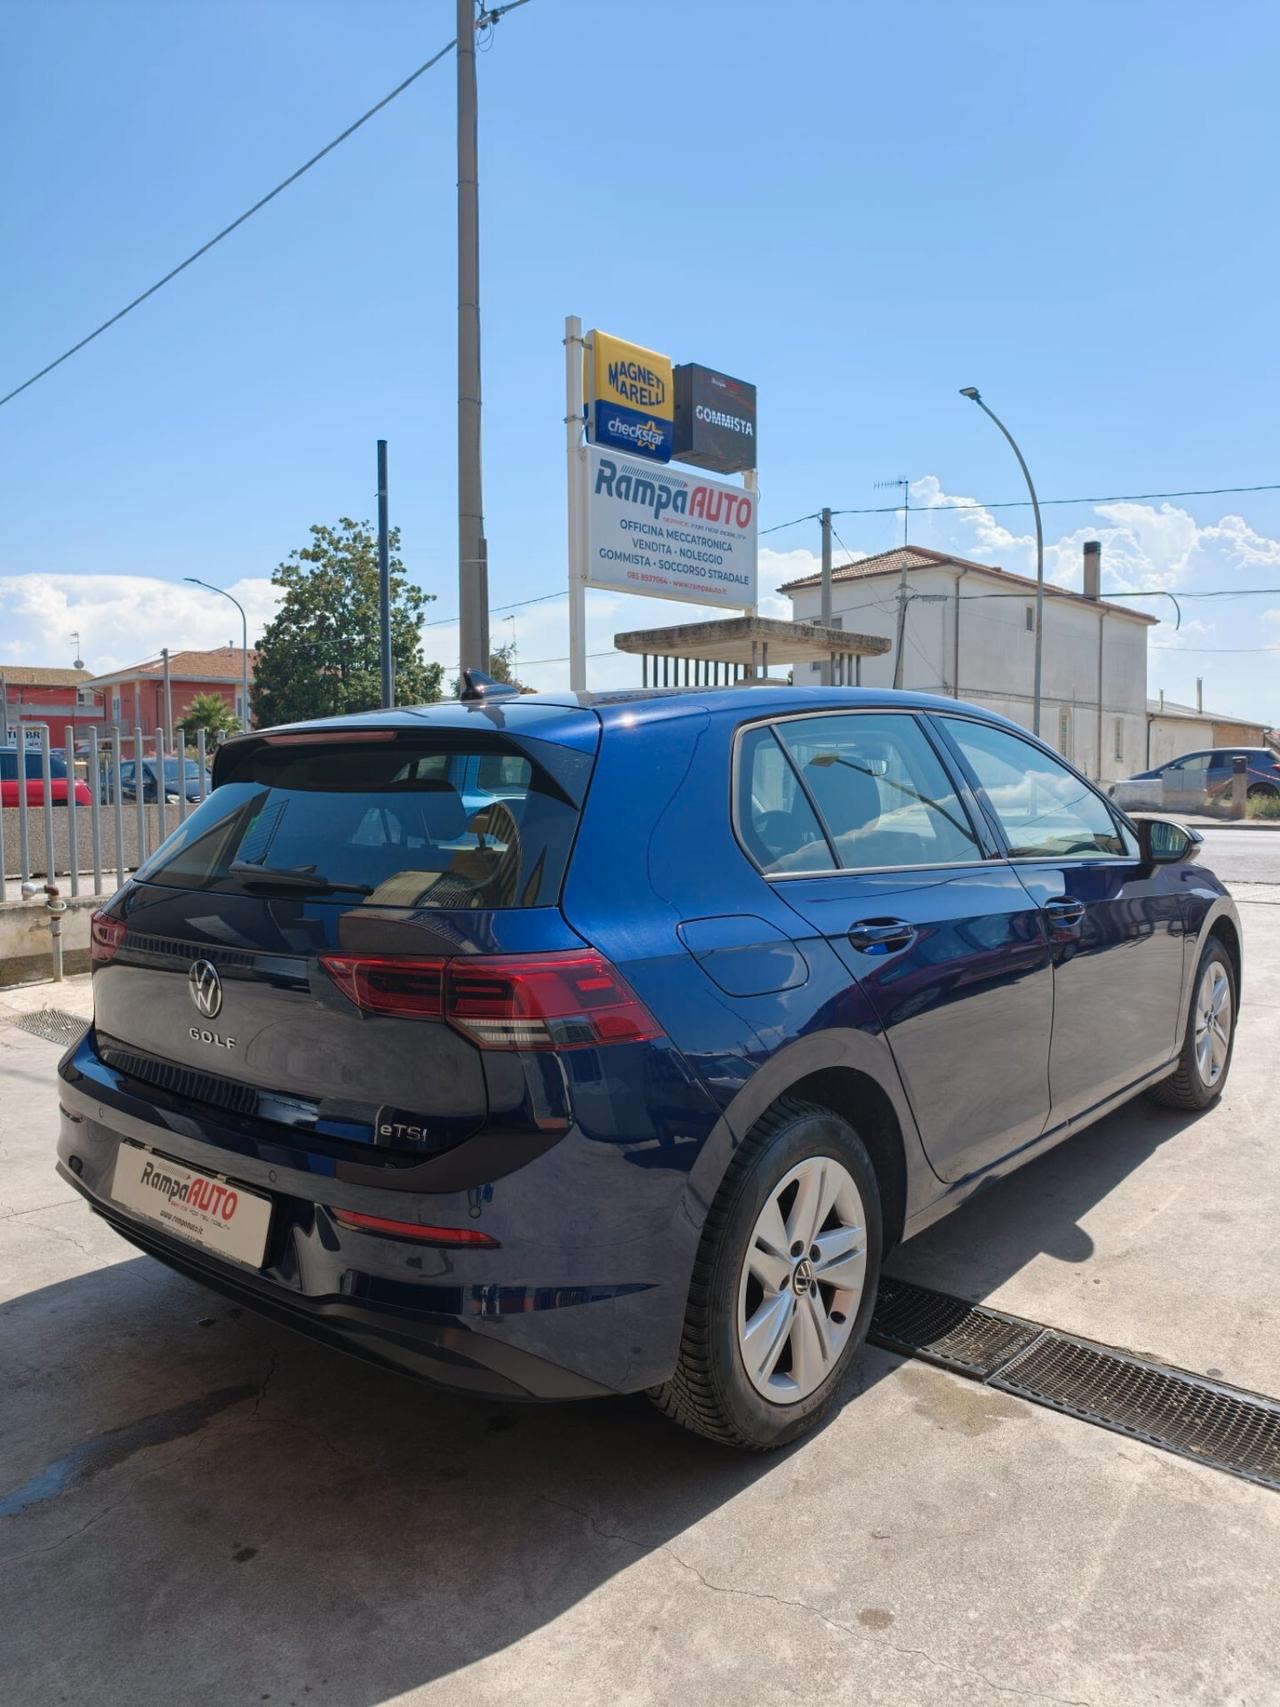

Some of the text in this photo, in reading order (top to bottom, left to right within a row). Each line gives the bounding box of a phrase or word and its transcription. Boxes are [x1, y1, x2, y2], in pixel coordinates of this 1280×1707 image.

[608, 361, 665, 391] MAGNETI
[608, 377, 665, 406] MARELLI
[608, 416, 665, 446] checkstar
[695, 405, 753, 436] GOMMISTA
[620, 519, 733, 552] OFFICINA MECCATRONICA
[632, 537, 723, 566] VENDITA NOLEGGIO
[599, 548, 749, 586] GOMMISTA SOCCORSO STRADALE
[189, 1027, 236, 1049] GOLF
[380, 1123, 427, 1142] eTSI
